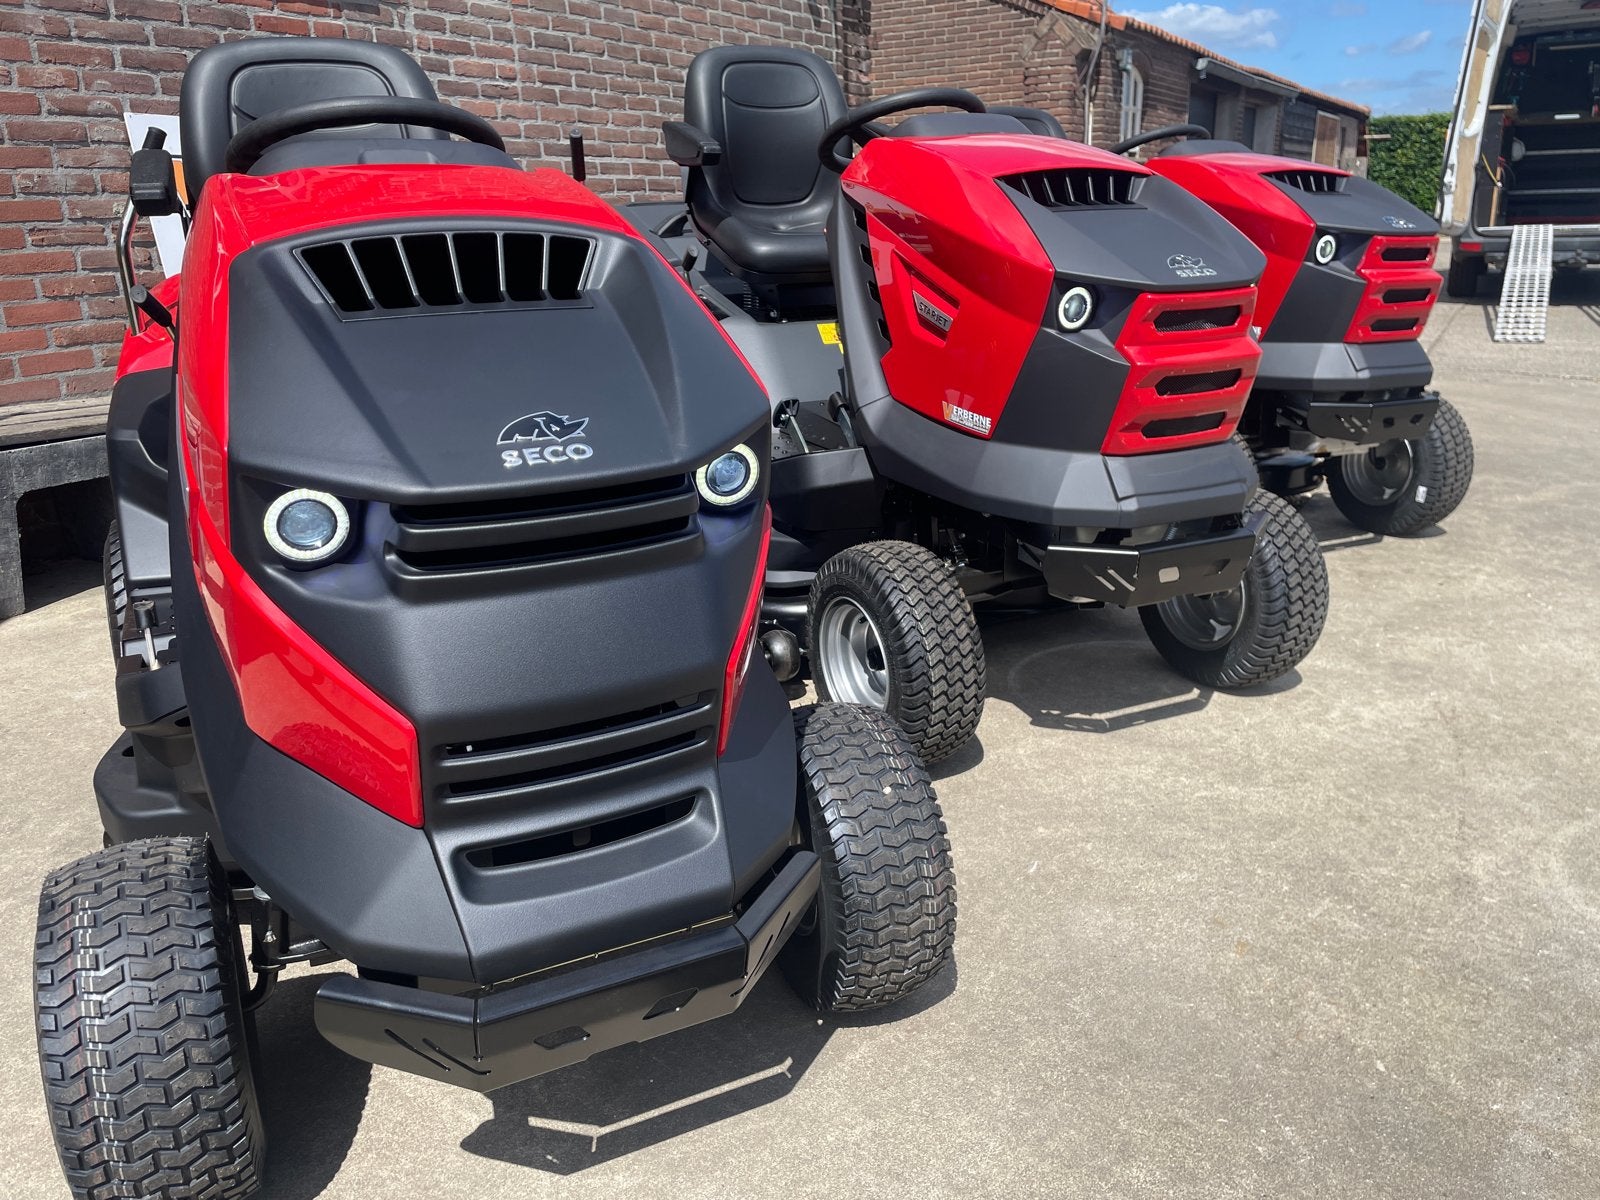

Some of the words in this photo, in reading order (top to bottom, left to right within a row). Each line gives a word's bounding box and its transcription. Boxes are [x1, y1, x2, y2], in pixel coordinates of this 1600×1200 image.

[1175, 267, 1217, 278] SECO
[918, 301, 948, 327] STARJET
[942, 400, 992, 427] VERBERNE
[501, 443, 593, 468] SECO
